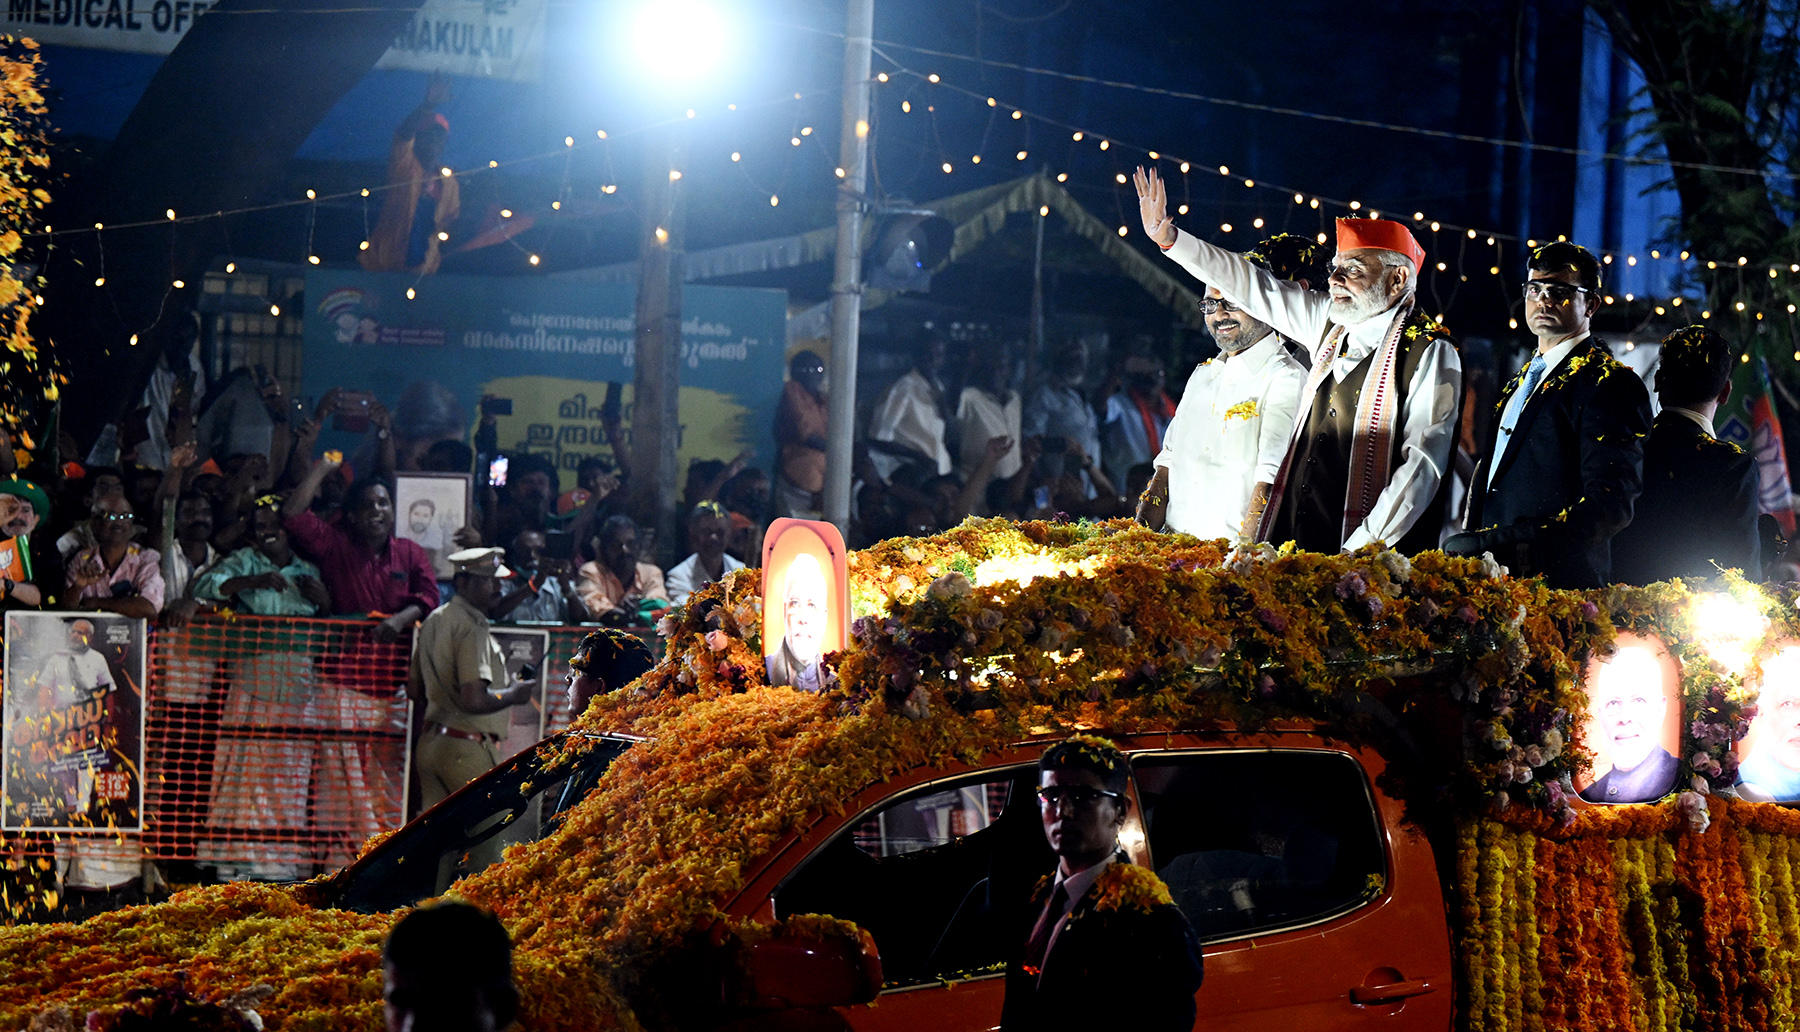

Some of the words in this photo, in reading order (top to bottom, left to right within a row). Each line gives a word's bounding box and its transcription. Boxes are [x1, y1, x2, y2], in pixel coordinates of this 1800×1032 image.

[8, 0, 141, 30] MEDICAL
[391, 19, 514, 58] NAKULAM
[108, 780, 122, 790] 16
[114, 790, 127, 798] PM
